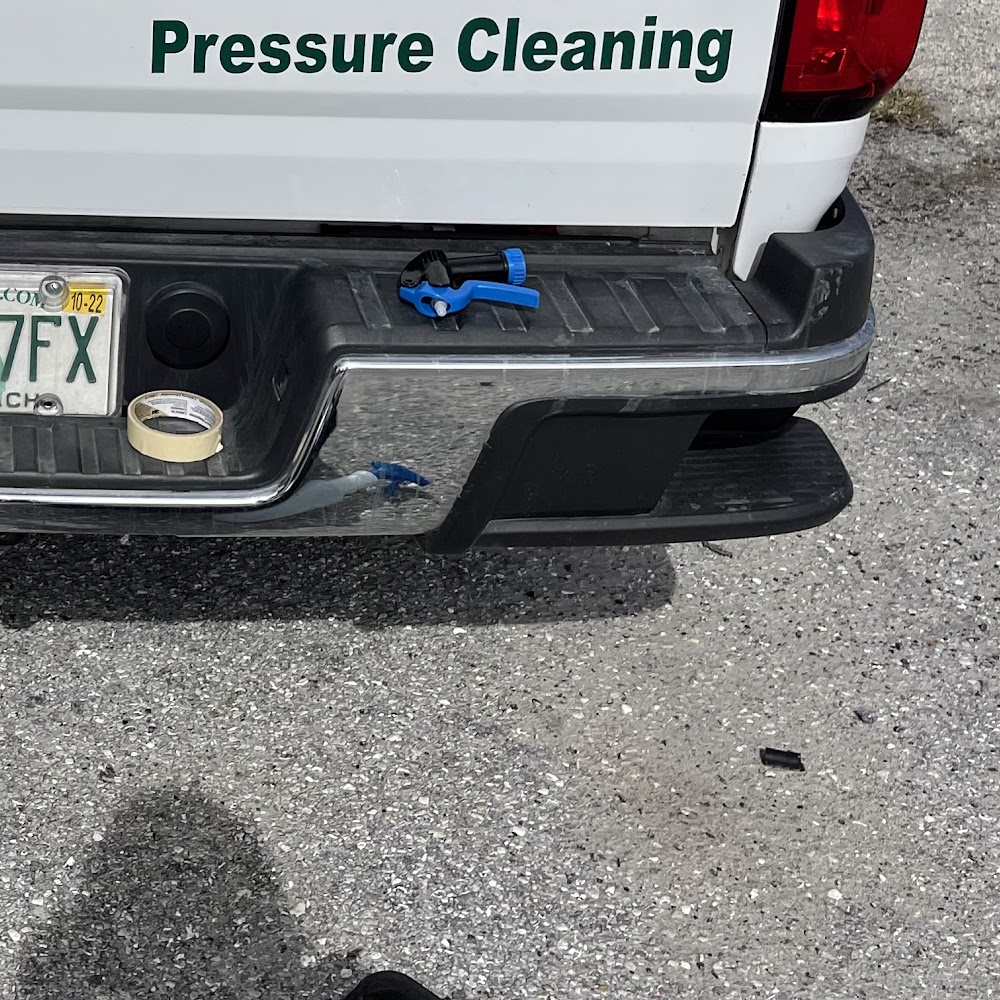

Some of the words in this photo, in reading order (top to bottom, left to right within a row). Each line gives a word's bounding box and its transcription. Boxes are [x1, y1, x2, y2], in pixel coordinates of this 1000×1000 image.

[151, 19, 434, 74] Pressure
[457, 16, 733, 83] Cleaning
[71, 292, 104, 314] 10-22
